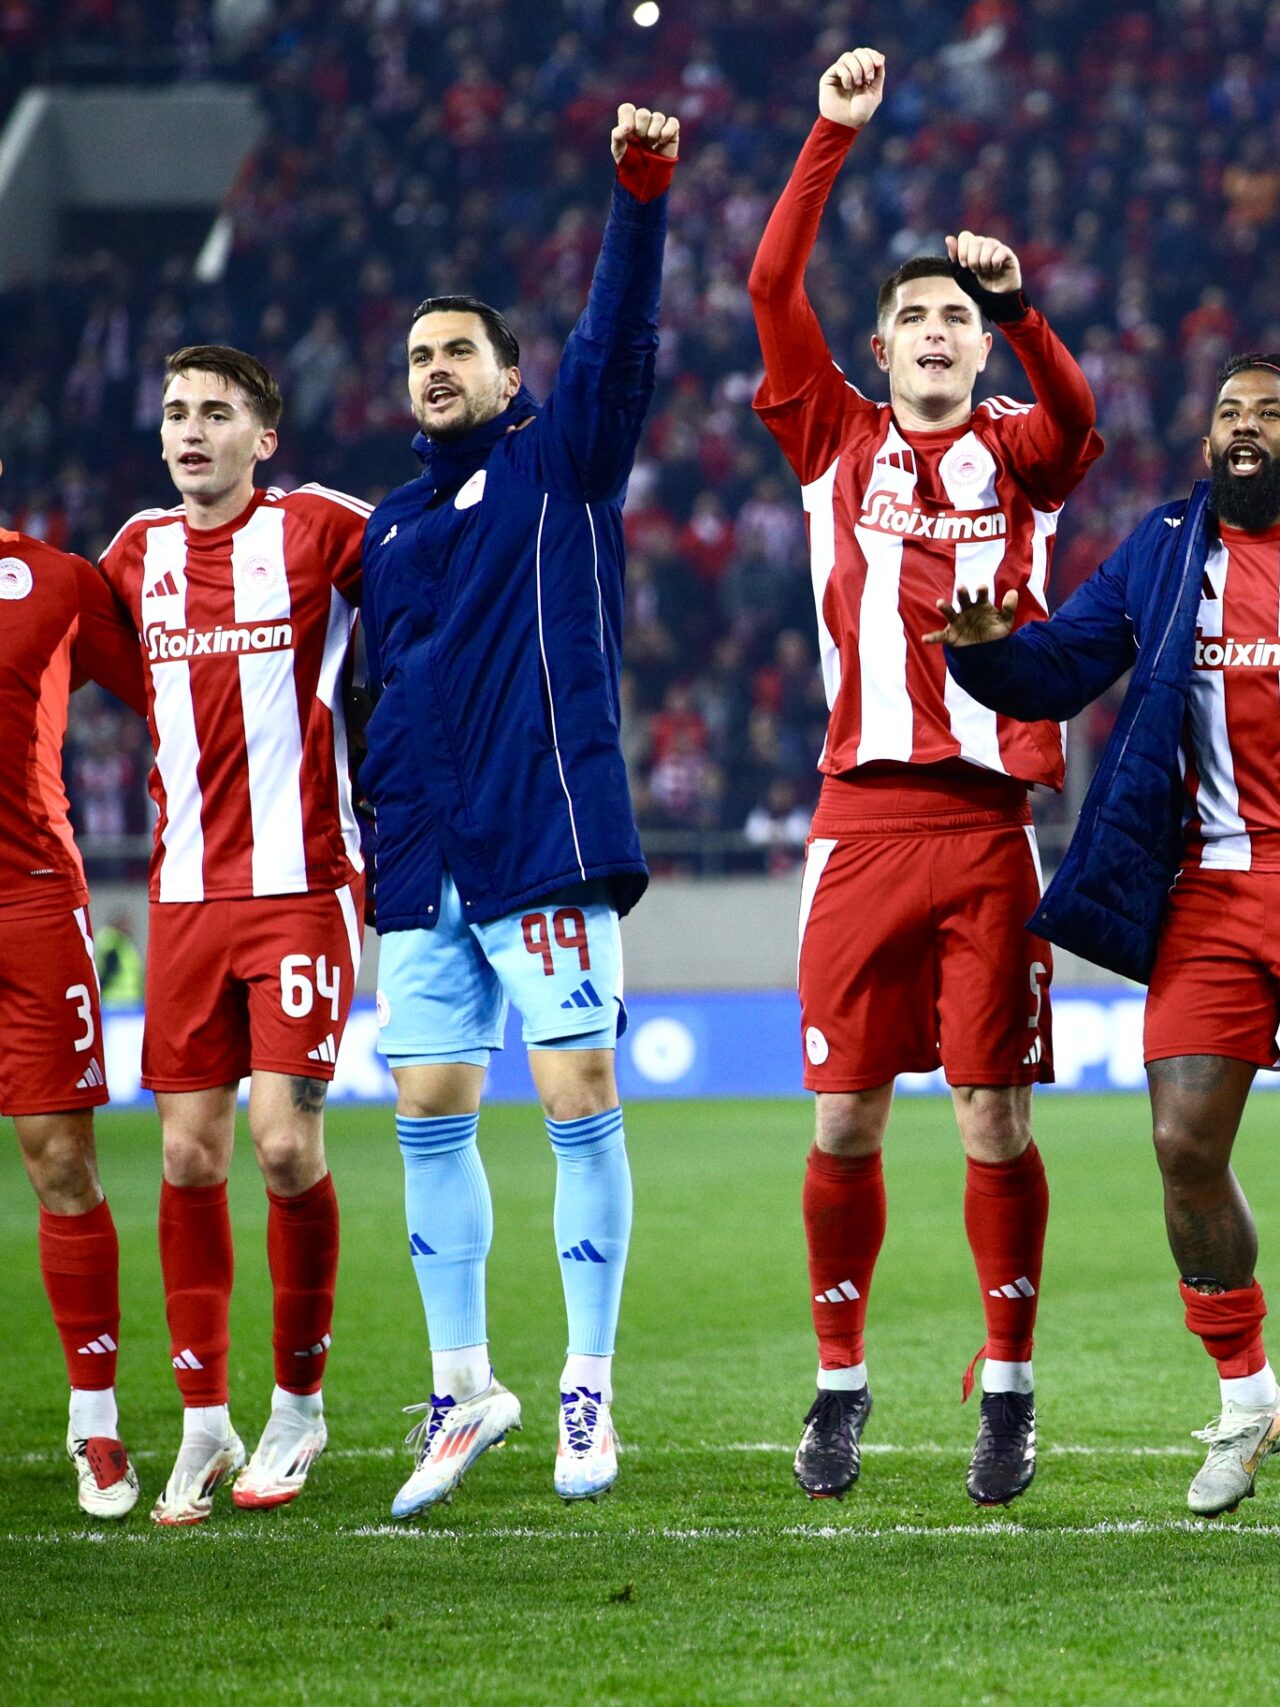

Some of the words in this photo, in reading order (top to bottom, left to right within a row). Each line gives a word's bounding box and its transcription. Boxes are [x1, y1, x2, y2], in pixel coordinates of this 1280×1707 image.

[859, 494, 1006, 540] Stoiximan
[148, 624, 293, 660] Stoiximan
[520, 907, 591, 976] 99
[65, 983, 95, 1052] 3
[279, 954, 341, 1021] 64
